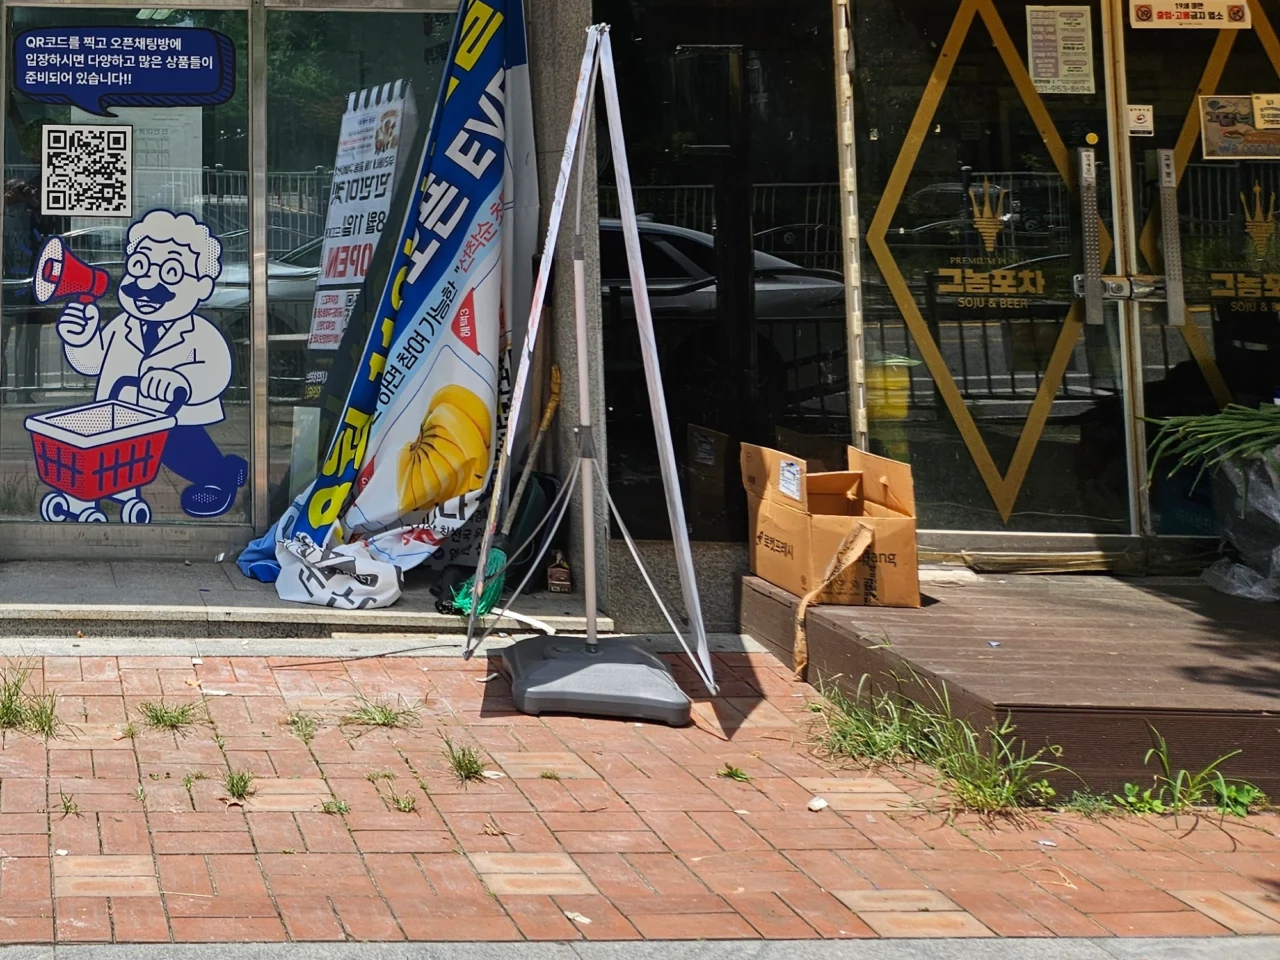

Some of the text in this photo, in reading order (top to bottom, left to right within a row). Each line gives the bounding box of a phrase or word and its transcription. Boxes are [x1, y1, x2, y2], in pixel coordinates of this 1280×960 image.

[25, 36, 182, 51] QR코드를 찍고 오픈채팅방에
[25, 53, 213, 69] 입장하시면 다양하고 많은 상품들이
[25, 71, 132, 86] 준비되어 있습니다!!
[938, 268, 1045, 294] 그놈포차
[958, 297, 1028, 308] SOJU & BEER
[397, 329, 430, 371] 참여
[419, 280, 459, 337] 가능한
[459, 308, 471, 338] 혜택3
[763, 534, 794, 561] 로켓프레시
